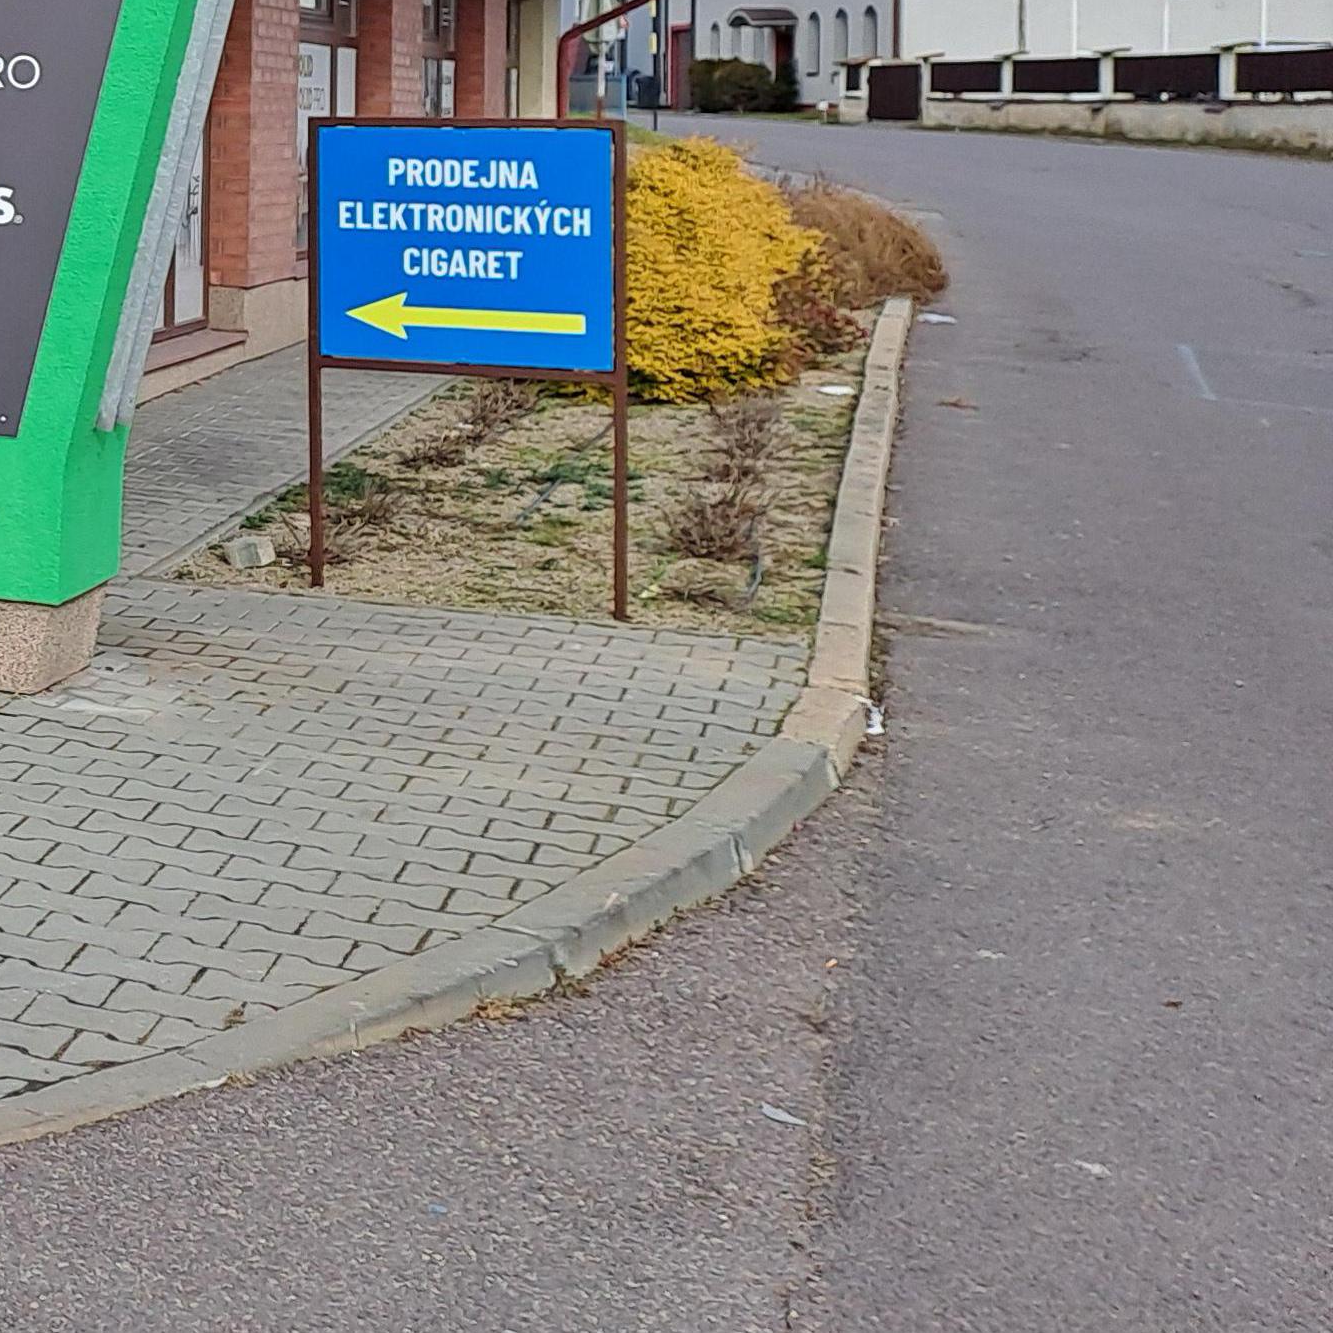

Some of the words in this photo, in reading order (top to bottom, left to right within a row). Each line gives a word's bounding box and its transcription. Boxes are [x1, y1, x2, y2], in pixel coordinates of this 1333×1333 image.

[388, 158, 539, 189] PRODEJNA
[339, 199, 591, 237] ELEKTRONICKÝCH
[403, 247, 523, 280] CIGARET
